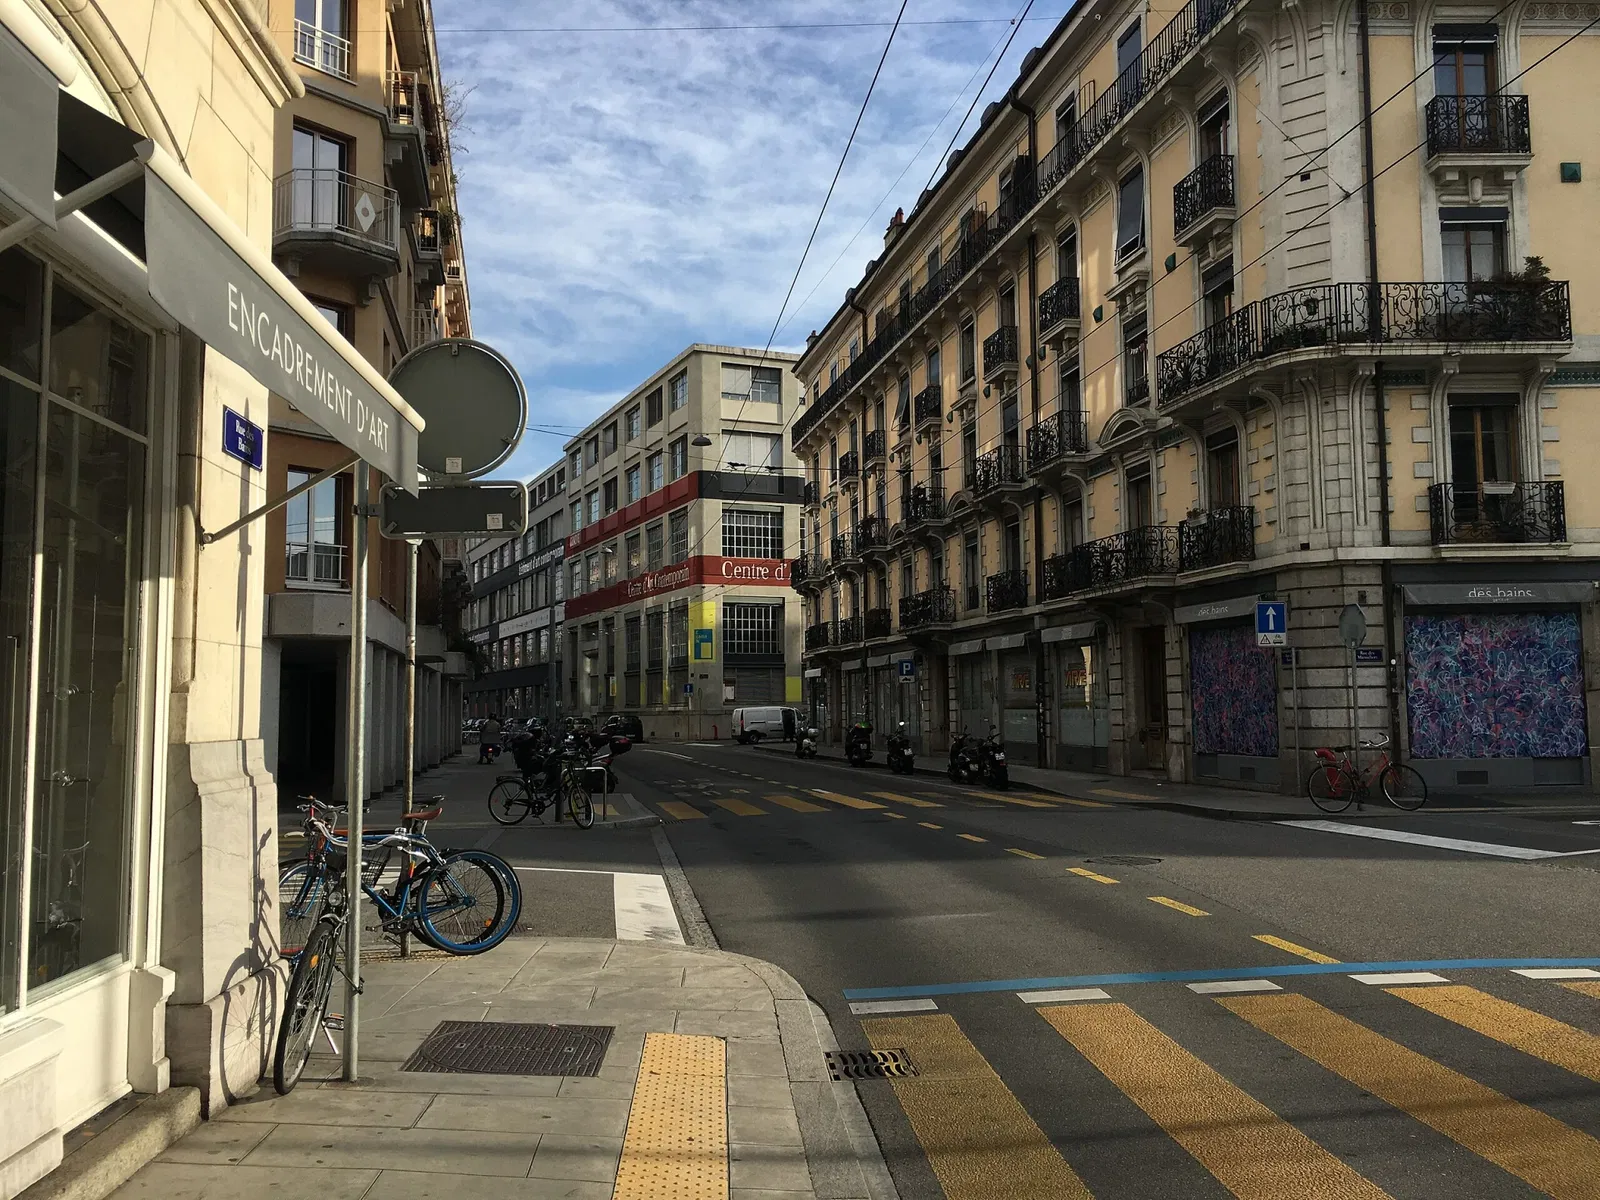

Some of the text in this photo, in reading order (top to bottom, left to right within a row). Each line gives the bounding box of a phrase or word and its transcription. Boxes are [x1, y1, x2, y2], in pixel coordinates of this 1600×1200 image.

[228, 281, 389, 453] ENCADREMENT D'ART
[235, 419, 255, 441] Rue des
[237, 436, 252, 456] Bains
[721, 560, 770, 581] Centre
[1468, 586, 1532, 598] des bains
[903, 662, 911, 675] P
